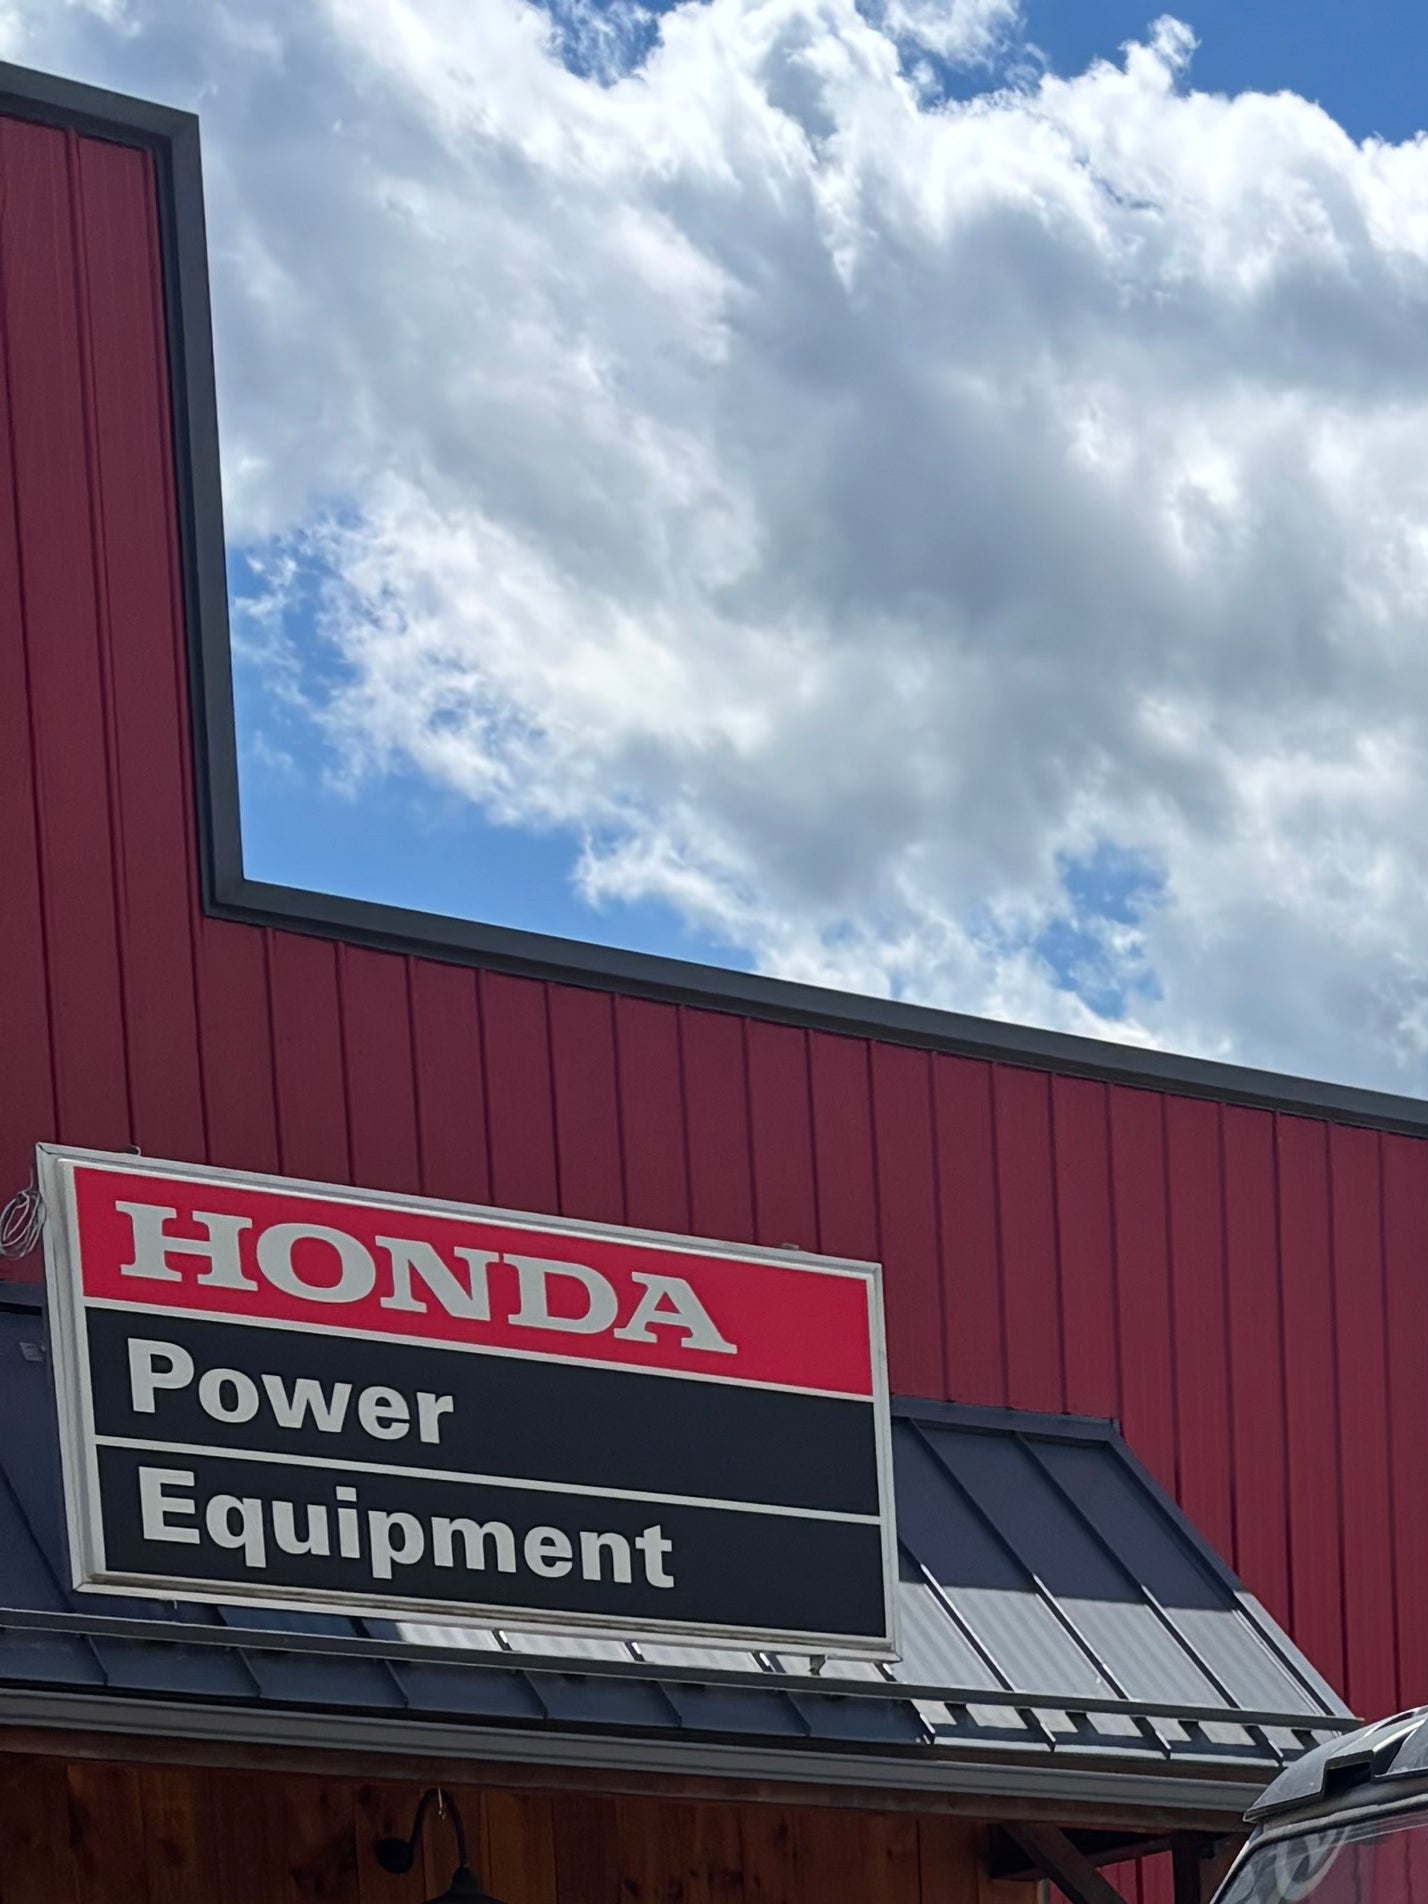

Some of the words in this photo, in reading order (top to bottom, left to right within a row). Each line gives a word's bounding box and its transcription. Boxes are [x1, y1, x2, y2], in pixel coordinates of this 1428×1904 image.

[115, 1199, 738, 1356] HONDA
[126, 1338, 454, 1444] Power
[138, 1465, 675, 1589] Equipment
